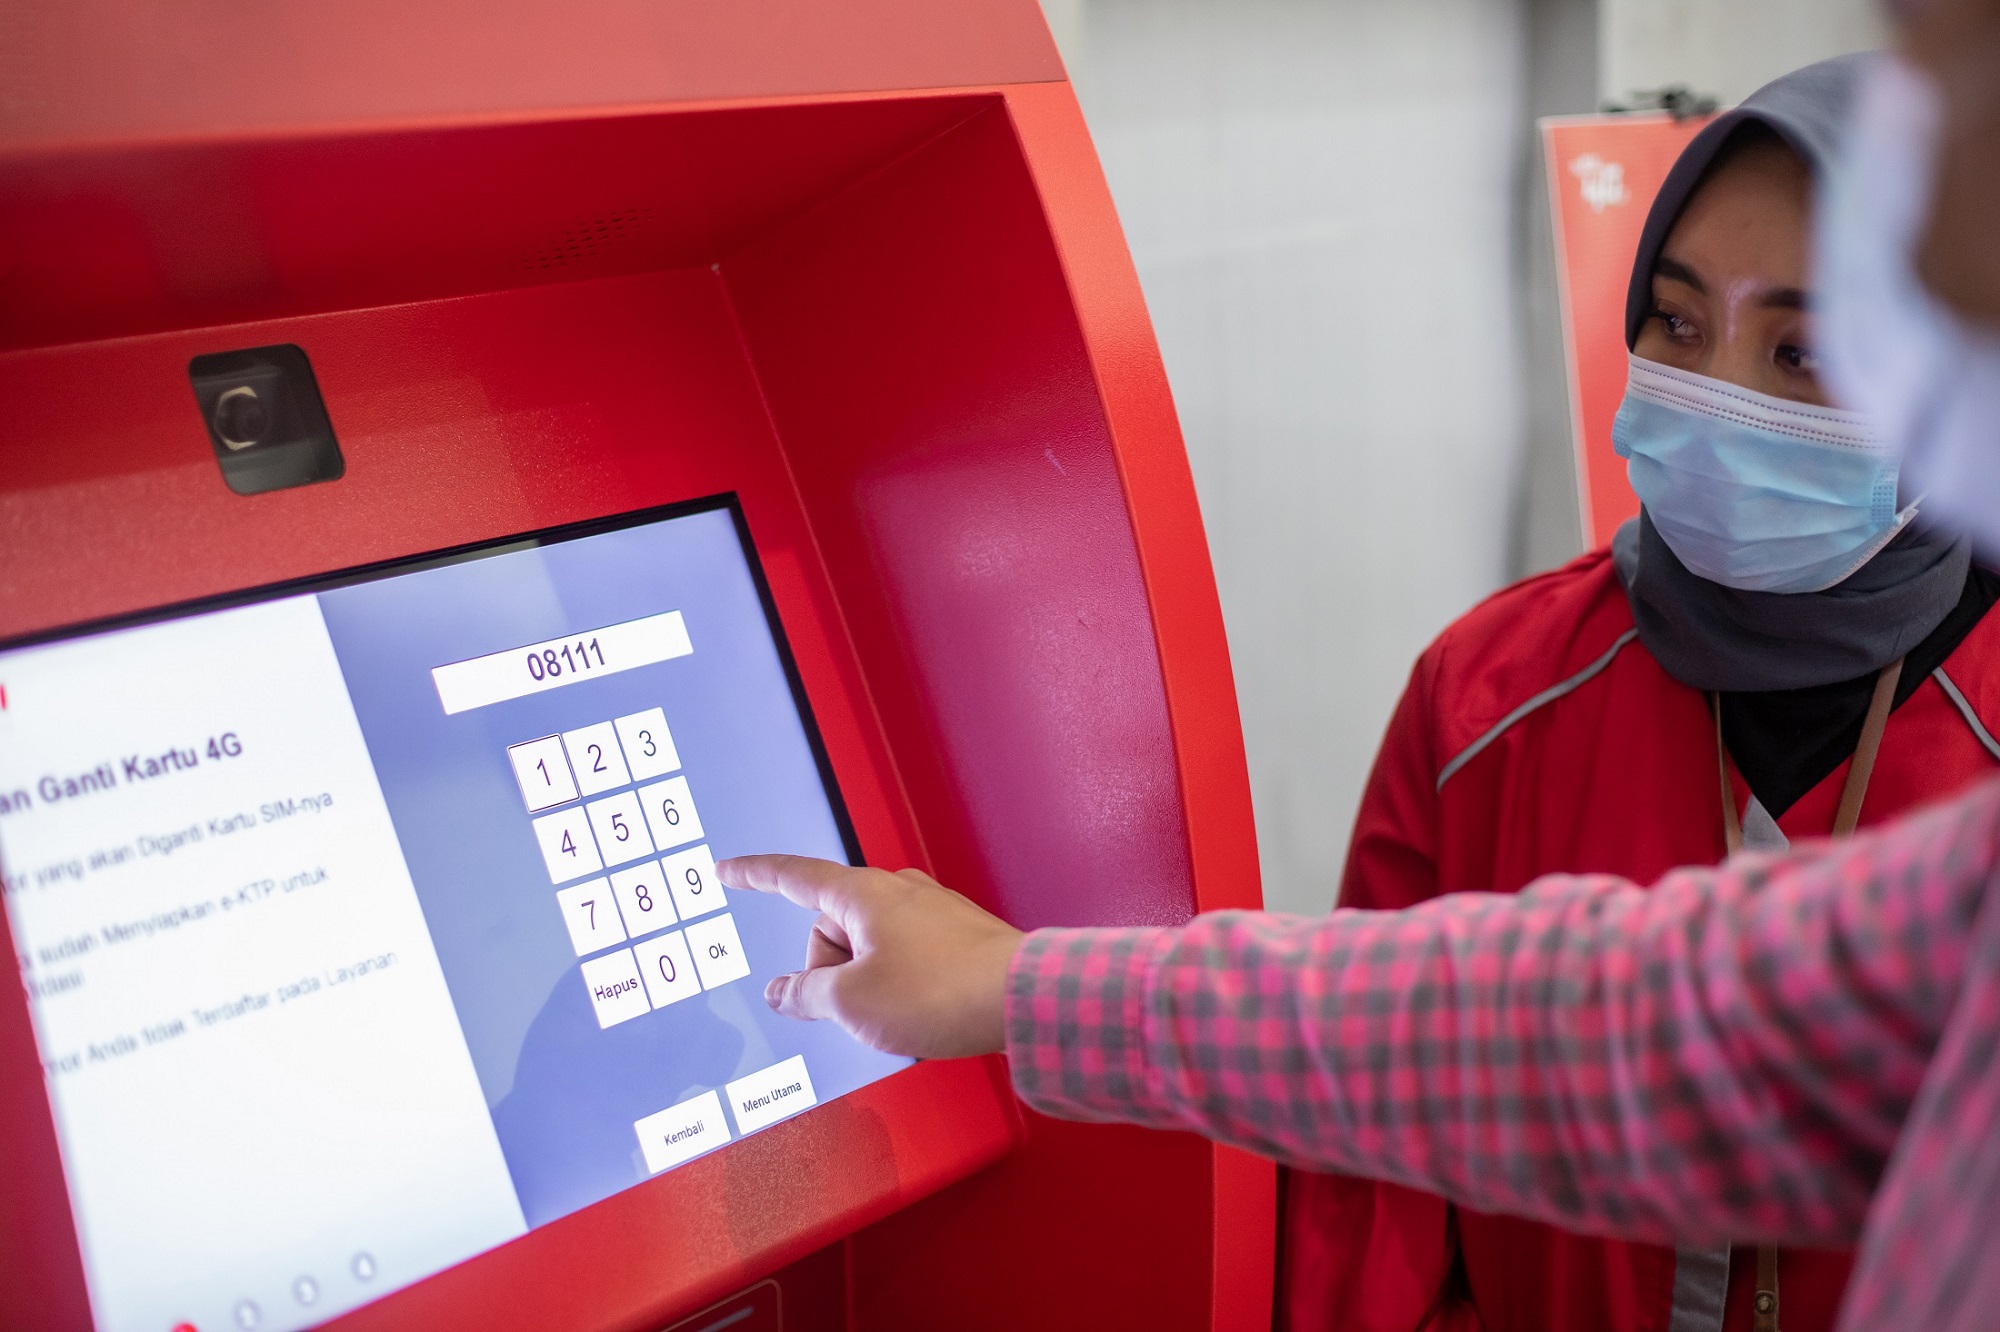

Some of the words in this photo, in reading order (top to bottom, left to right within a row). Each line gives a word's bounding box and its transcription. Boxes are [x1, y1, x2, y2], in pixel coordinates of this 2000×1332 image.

[527, 638, 606, 681] 08111
[639, 730, 657, 757] 3
[38, 762, 117, 803] Ganti
[122, 748, 199, 782] Kartu
[207, 733, 243, 760] 4G
[537, 758, 551, 786] 1
[587, 744, 607, 772] 2
[662, 799, 680, 826] 6
[36, 861, 84, 889] yang
[88, 845, 135, 871] akan
[137, 823, 204, 857] Diganti
[208, 812, 257, 836] Kartu
[260, 792, 333, 823] SIM-nya
[612, 813, 630, 842] 5
[561, 829, 577, 858] 4
[221, 879, 275, 910] e-KTP
[283, 867, 330, 893] untuk
[685, 868, 702, 895] 9
[635, 884, 653, 912] 8
[581, 900, 596, 930] 7
[709, 942, 728, 960] Ok
[277, 976, 321, 1003] pada
[326, 951, 398, 986] Layanan
[659, 955, 676, 982] 0
[594, 976, 638, 1002] Hapus
[742, 1095, 771, 1113] Menu
[770, 1079, 802, 1101] Utama
[663, 1120, 705, 1146] Kembali
